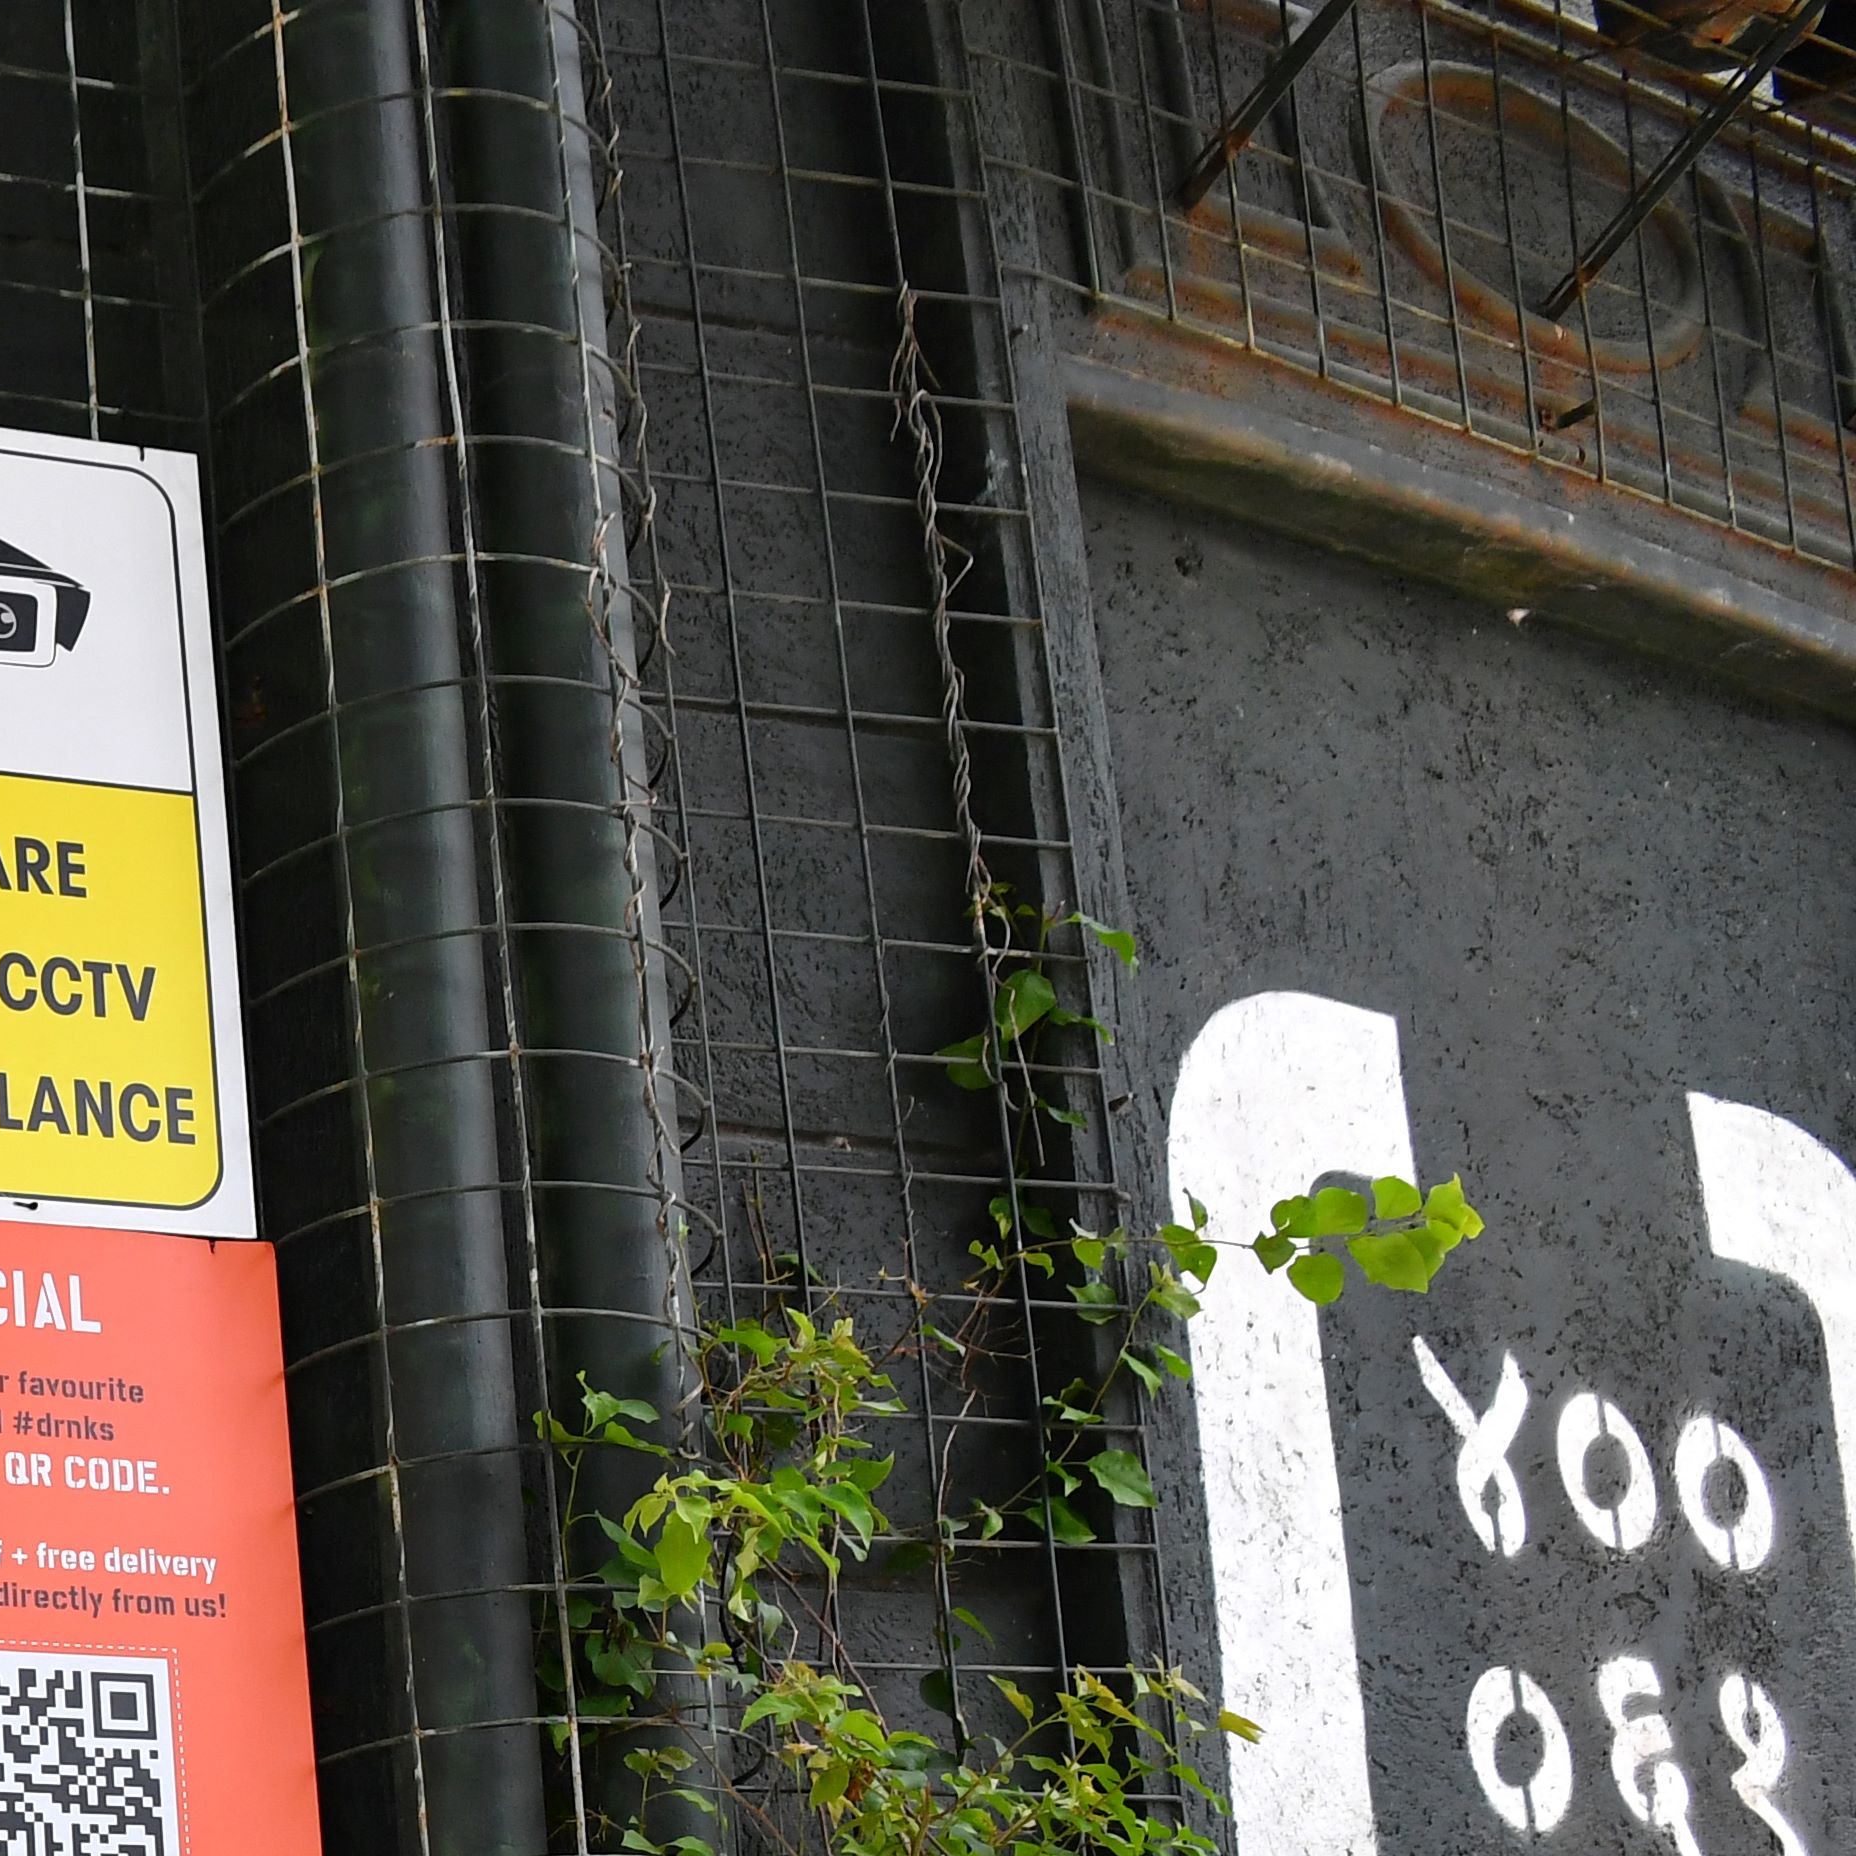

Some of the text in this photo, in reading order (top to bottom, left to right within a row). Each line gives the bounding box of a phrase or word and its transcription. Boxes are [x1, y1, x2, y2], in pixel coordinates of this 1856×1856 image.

[18, 1370, 144, 1403] favourite
[12, 1411, 114, 1441] #drnks
[5, 1451, 52, 1488] QR
[64, 1455, 170, 1494] CODE.
[11, 1547, 28, 1565] +
[36, 1543, 95, 1573] free
[104, 1545, 217, 1584] delivery
[111, 1588, 176, 1615] from
[183, 1592, 226, 1618] us!
